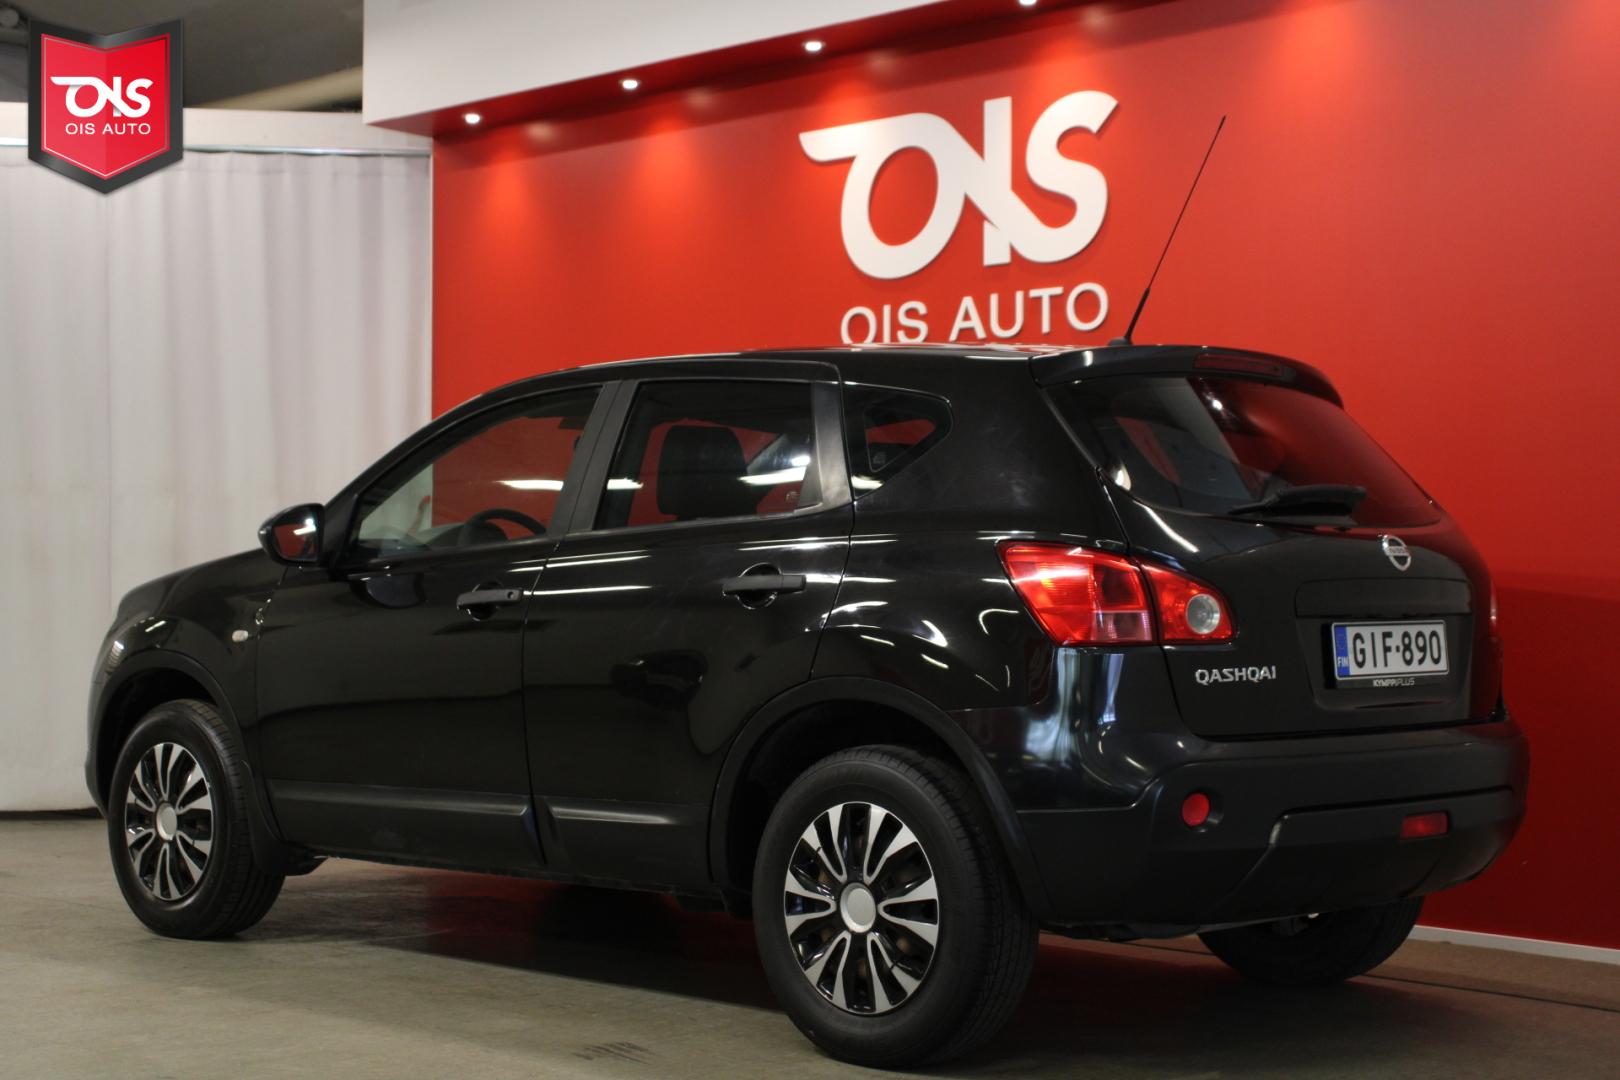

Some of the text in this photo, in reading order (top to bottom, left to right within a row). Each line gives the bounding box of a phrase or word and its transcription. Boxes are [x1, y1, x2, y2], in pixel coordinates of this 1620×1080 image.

[840, 282, 1109, 344] OIS AUTO
[1337, 656, 1350, 667] FIN
[1353, 630, 1441, 668] GIF-890
[1195, 665, 1277, 686] QASHQAI
